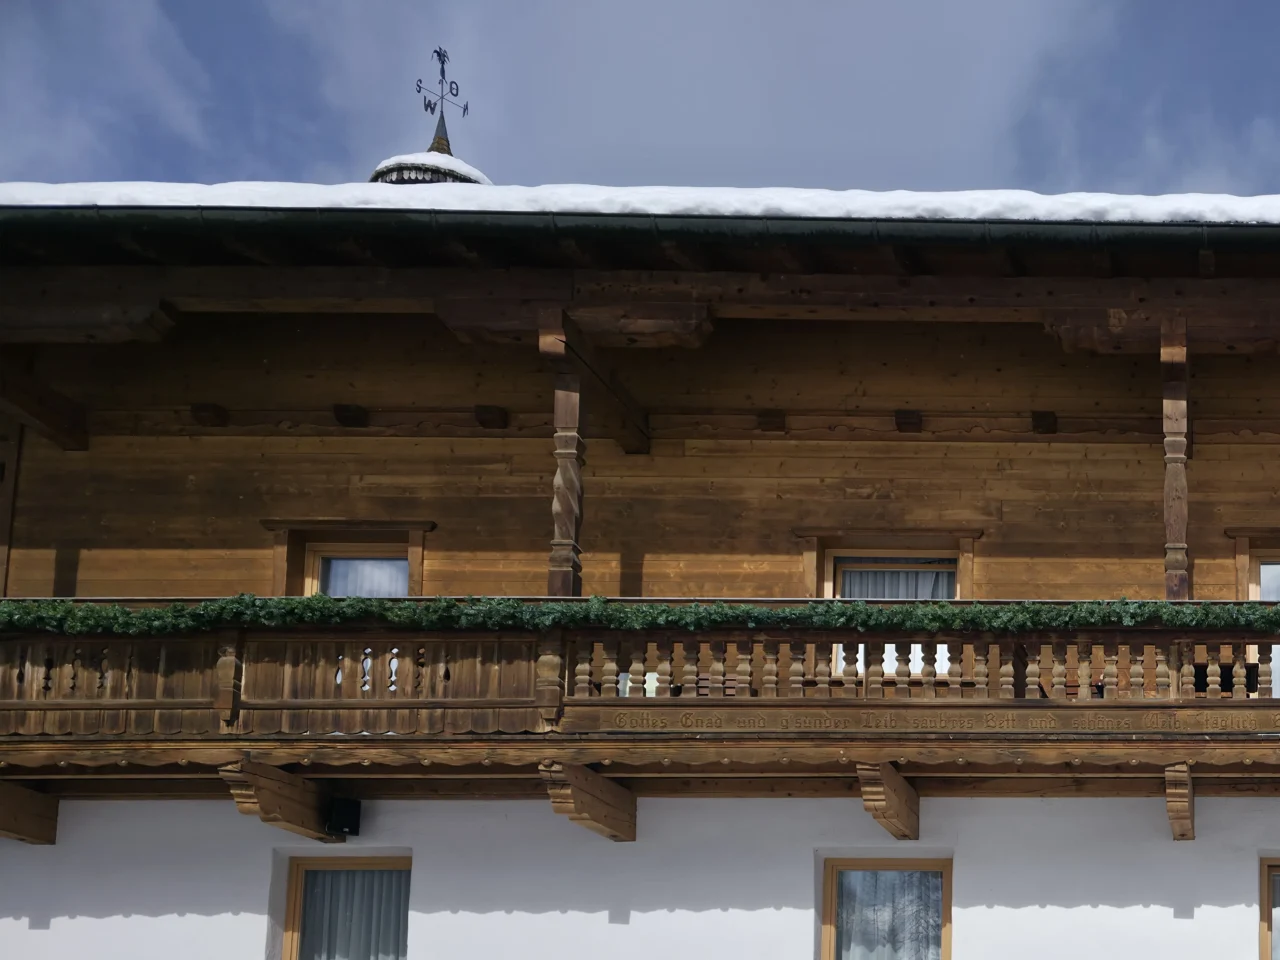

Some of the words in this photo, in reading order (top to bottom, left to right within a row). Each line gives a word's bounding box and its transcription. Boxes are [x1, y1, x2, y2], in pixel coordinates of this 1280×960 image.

[423, 95, 438, 115] W
[614, 712, 668, 728] Gottes
[736, 712, 766, 728] und
[984, 712, 1016, 729] Bett
[1028, 712, 1057, 729] und
[1072, 713, 1131, 730] schönes
